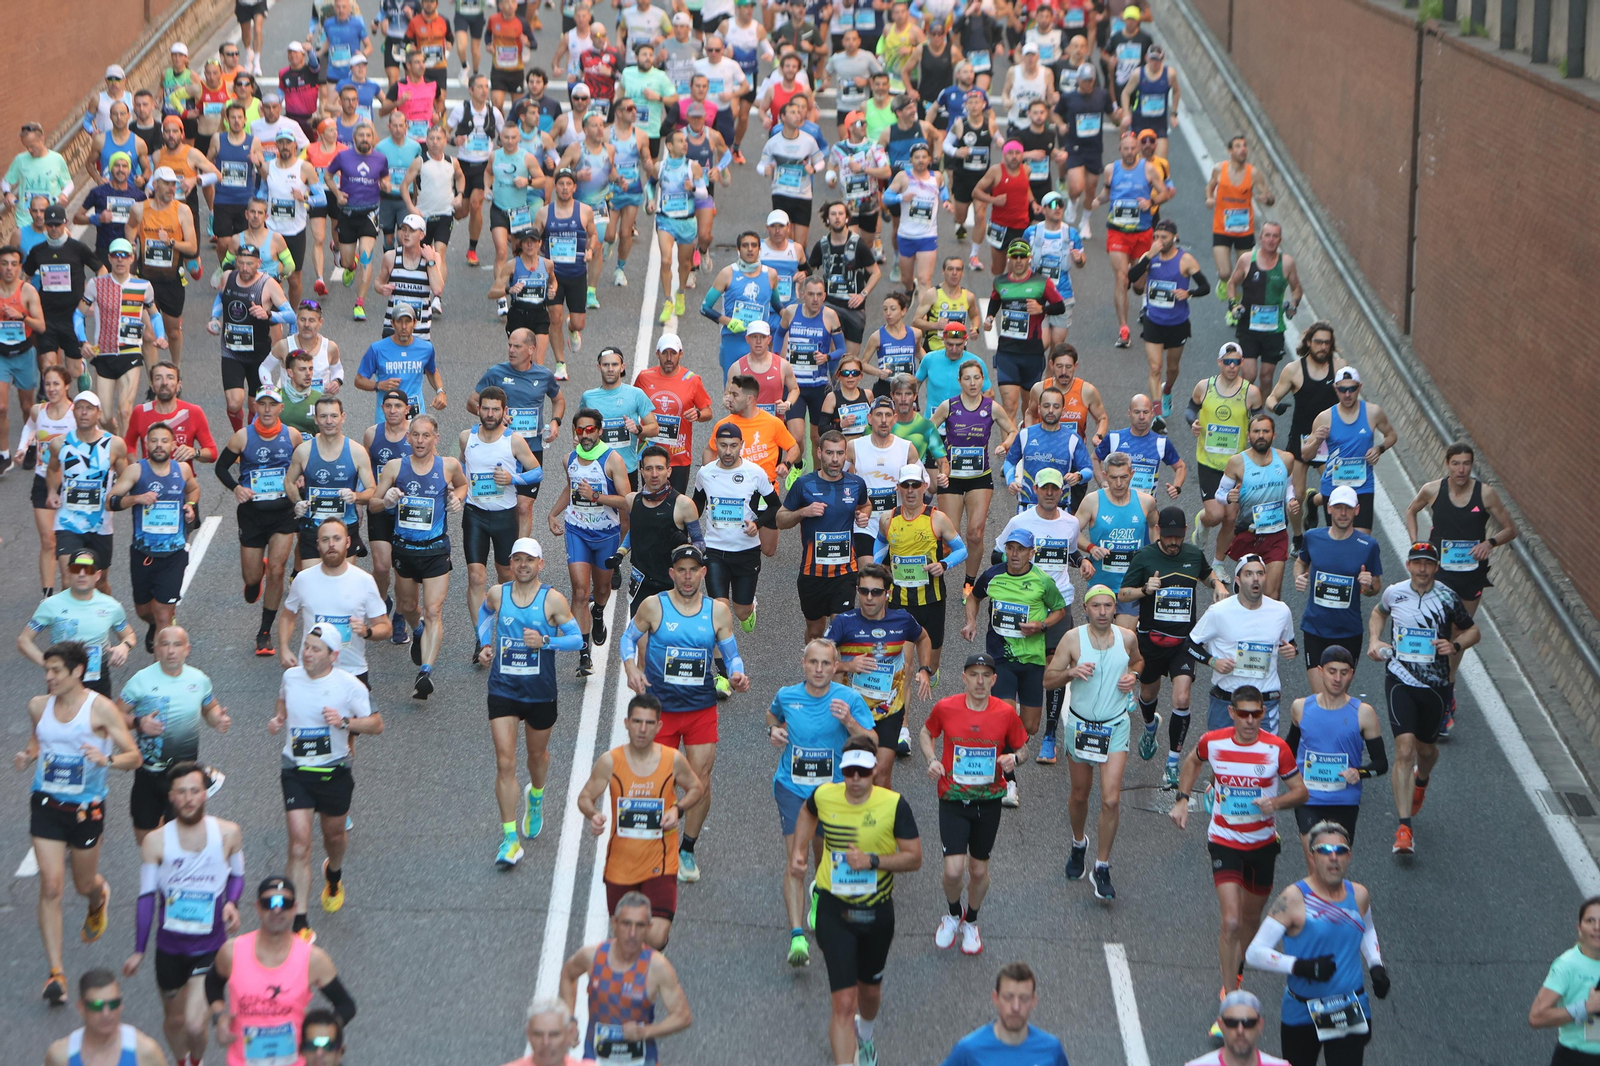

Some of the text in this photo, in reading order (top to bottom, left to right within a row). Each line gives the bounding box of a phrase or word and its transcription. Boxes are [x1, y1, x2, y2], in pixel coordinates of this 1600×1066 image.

[386, 361, 422, 370] IRONTEAM
[746, 444, 768, 455] BEER
[1109, 528, 1135, 540] 42K
[1220, 776, 1260, 787] CAVIC
